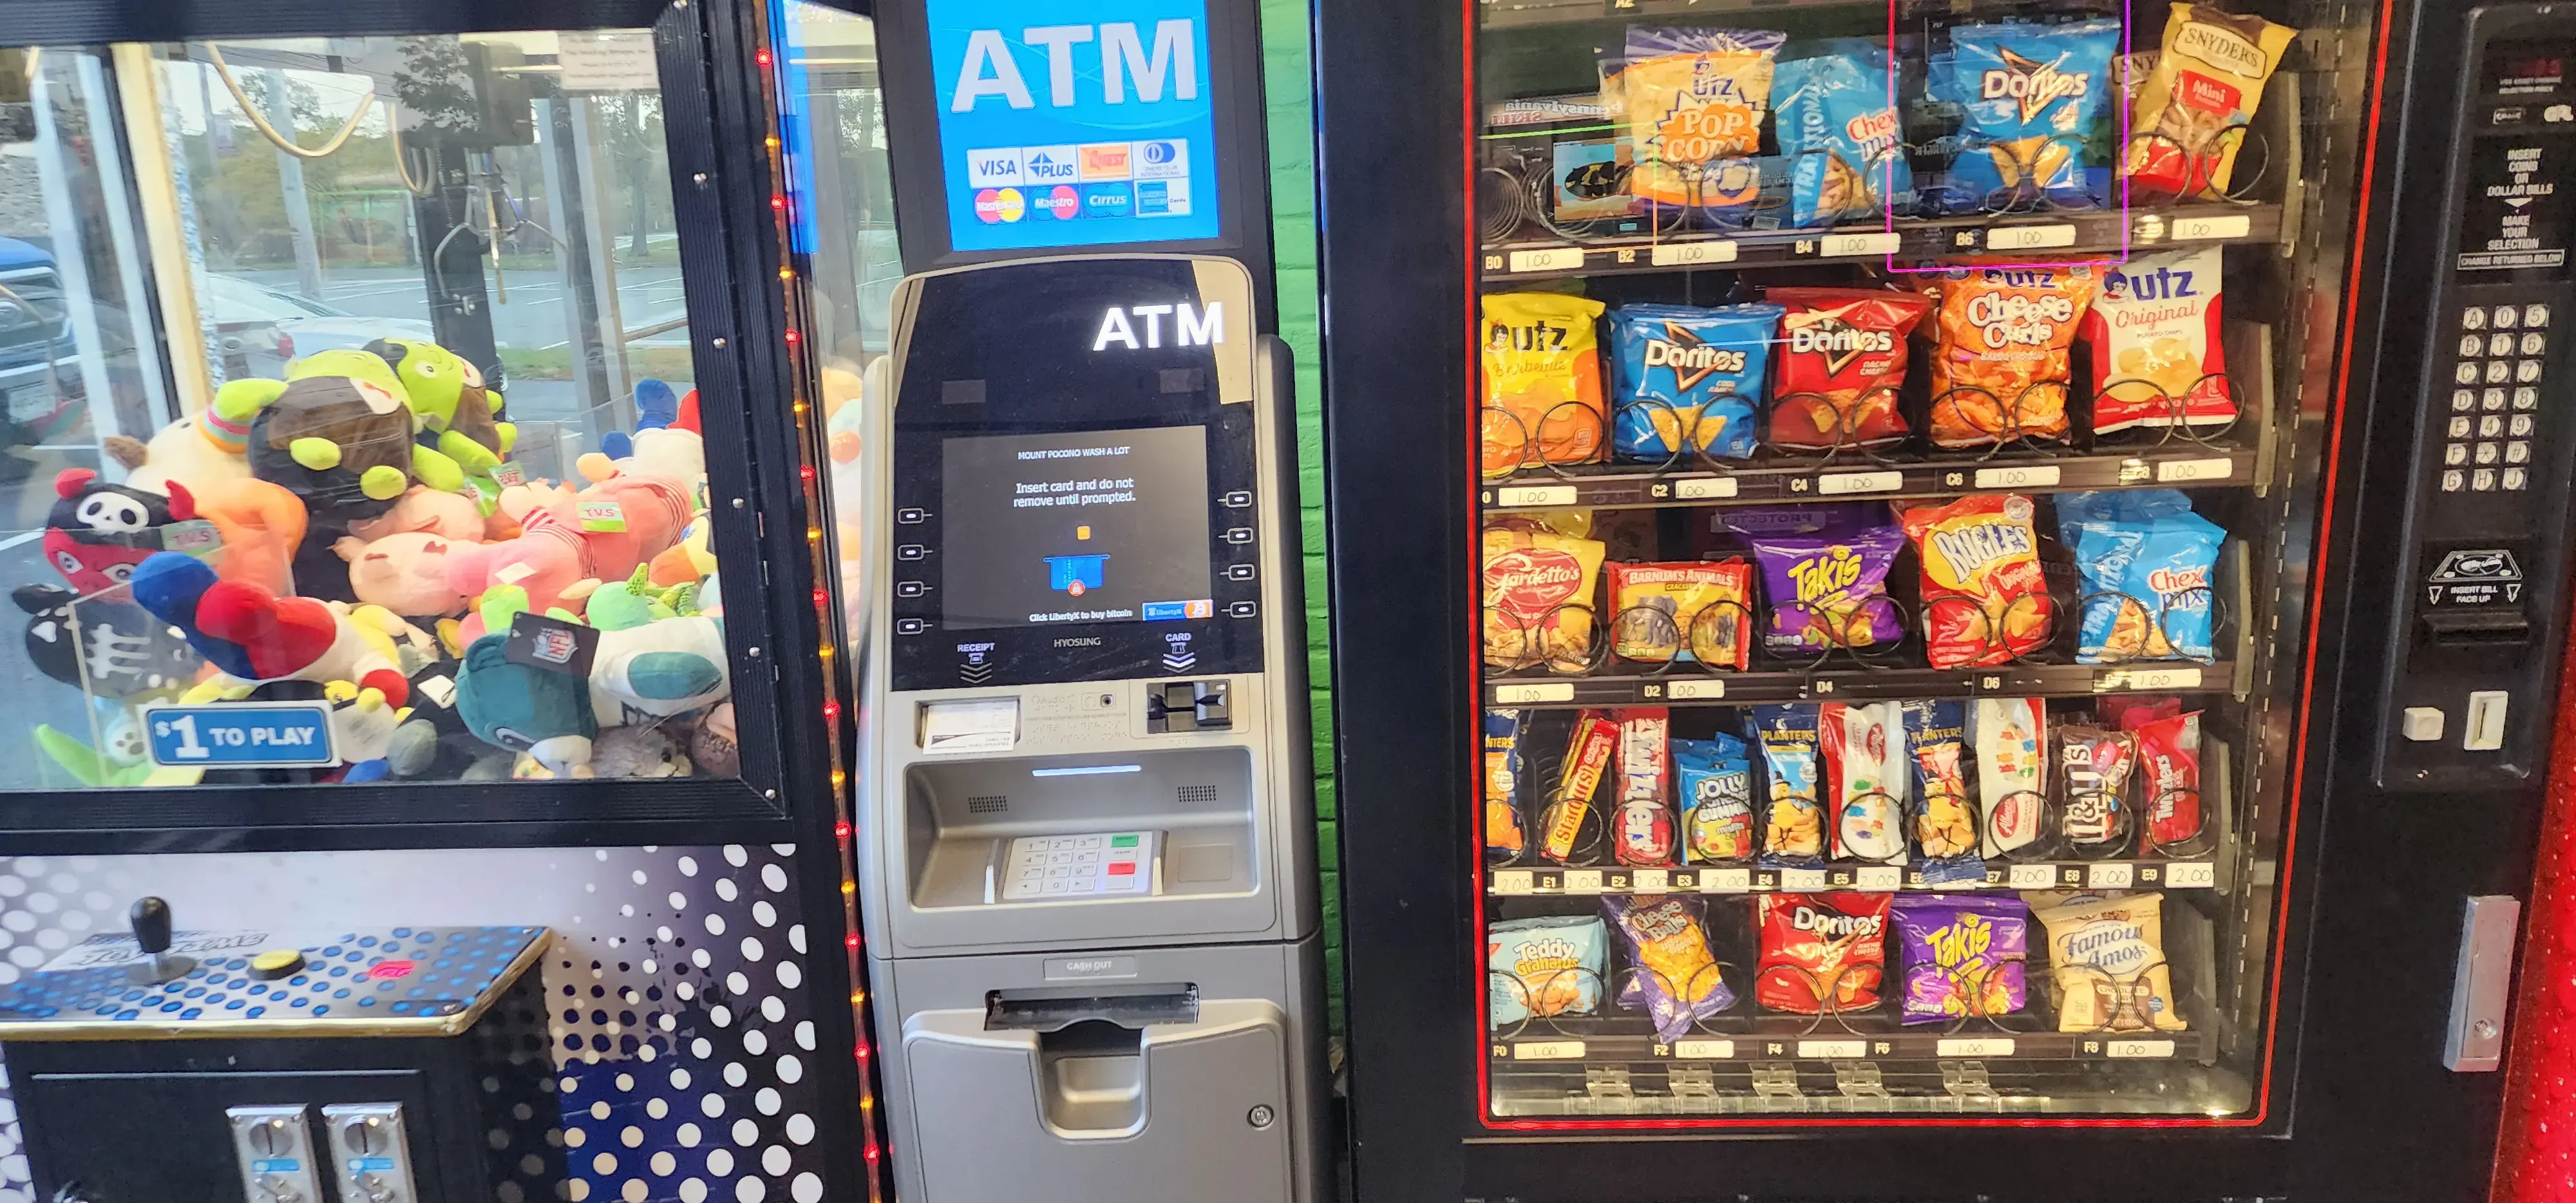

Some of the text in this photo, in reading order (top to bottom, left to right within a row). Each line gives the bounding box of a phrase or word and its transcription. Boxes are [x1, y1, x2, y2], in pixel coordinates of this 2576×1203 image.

[951, 17, 1198, 113] ATM
[1983, 68, 2090, 100] Doritos
[2193, 79, 2227, 103] Mini
[1681, 108, 1747, 139] POP
[1848, 107, 1897, 141] Chex
[1666, 134, 1750, 162] CORN
[2507, 148, 2543, 160] INSERT
[979, 160, 1074, 178] VISA PLUS
[2508, 160, 2538, 172] COINS
[2515, 173, 2529, 184] OR
[2487, 183, 2553, 196] DOLLAR BILLS
[1035, 196, 1074, 209] Maestro
[1089, 194, 1127, 206] Cirrus
[2502, 214, 2530, 226] MAKE
[1955, 232, 1975, 246] B6
[2502, 227, 2528, 238] YOUR
[1794, 240, 1814, 254] B4
[2487, 238, 2540, 251] SELECTION
[1484, 255, 1503, 270] B0
[1617, 249, 1636, 263] B2
[2461, 253, 2562, 267] CHANGE RETURNED BELOW
[1967, 292, 2074, 329] Cheese
[2115, 300, 2199, 330] Original
[2501, 310, 2510, 324] 0
[2531, 308, 2541, 323] 5
[2468, 311, 2479, 325] A
[1094, 301, 1225, 352] ATM
[1792, 328, 1893, 354] Doritos
[1982, 322, 2053, 348] Curls
[2465, 338, 2475, 352] B
[2497, 337, 2505, 351] 1
[2527, 337, 2536, 350] 6
[1645, 339, 1748, 373] Doritos
[2462, 365, 2472, 379] C
[2492, 365, 2502, 379] 2
[2523, 364, 2533, 377] 7
[2458, 393, 2468, 407] D
[2488, 392, 2498, 406] 3
[2520, 392, 2529, 405] 8
[2455, 420, 2465, 433] E
[2485, 419, 2494, 433] 4
[2515, 419, 2525, 431] 9
[1018, 446, 1131, 460] MOUNT POCONO WASH A LOT
[2451, 446, 2461, 460] F
[1016, 477, 1134, 495] Insert card and do not
[1790, 478, 1808, 492] C4
[1946, 472, 1964, 486] C6
[2447, 474, 2458, 488] G
[2477, 473, 2488, 487] H
[2508, 473, 2517, 486] J
[1517, 490, 1548, 503] 1.00
[1651, 484, 1669, 497] C2
[1013, 491, 1137, 508] remove until prompted.
[1932, 524, 2031, 585] BUGLES
[1685, 569, 1734, 587] ANIMALS
[1787, 551, 1863, 612] Takis
[2150, 567, 2205, 592] Chex
[2450, 584, 2498, 594] INSERT BILL
[2160, 588, 2205, 611] mix
[2456, 594, 2491, 603] FACE UP
[1029, 612, 1048, 622] Click
[1048, 611, 1081, 622] LibertyX
[1091, 611, 1106, 621] buy
[1106, 609, 1133, 618] bitcoin
[547, 629, 571, 658] NFL
[1054, 636, 1102, 648] HYOSUNG
[1166, 632, 1192, 642] CARD
[957, 643, 996, 653] RECEIPT
[1816, 680, 1834, 693] D4
[1982, 677, 2000, 689] D6
[1644, 685, 1662, 697] D2
[154, 714, 315, 759] $1 TO PLAY
[1761, 729, 1817, 742] PLANTERS
[1911, 725, 1963, 743] PLANTERS
[1696, 772, 1746, 801] JOLLY
[1611, 875, 1626, 887] E2
[1677, 875, 1692, 886] E3
[1757, 874, 1774, 885] E4
[1833, 873, 1850, 884] E5
[1986, 871, 2002, 884] E7
[2065, 869, 2081, 882] E8
[2141, 868, 2158, 881] E9
[1542, 876, 1557, 888] E1
[1631, 900, 1683, 932] Cheese
[1794, 906, 1883, 936] Doritos
[1645, 913, 1689, 943] Balls
[1513, 938, 1576, 961] Teddy
[1926, 917, 1991, 979] Takis
[2085, 945, 2143, 971] Amos
[1066, 960, 1112, 971] CASH OUT
[1514, 957, 1579, 977] Grahams
[1492, 1045, 1508, 1057] F0
[1653, 1045, 1669, 1056] F2
[1767, 1042, 1783, 1055] F4
[1875, 1042, 1891, 1054] F6
[2083, 1041, 2099, 1053] F8
